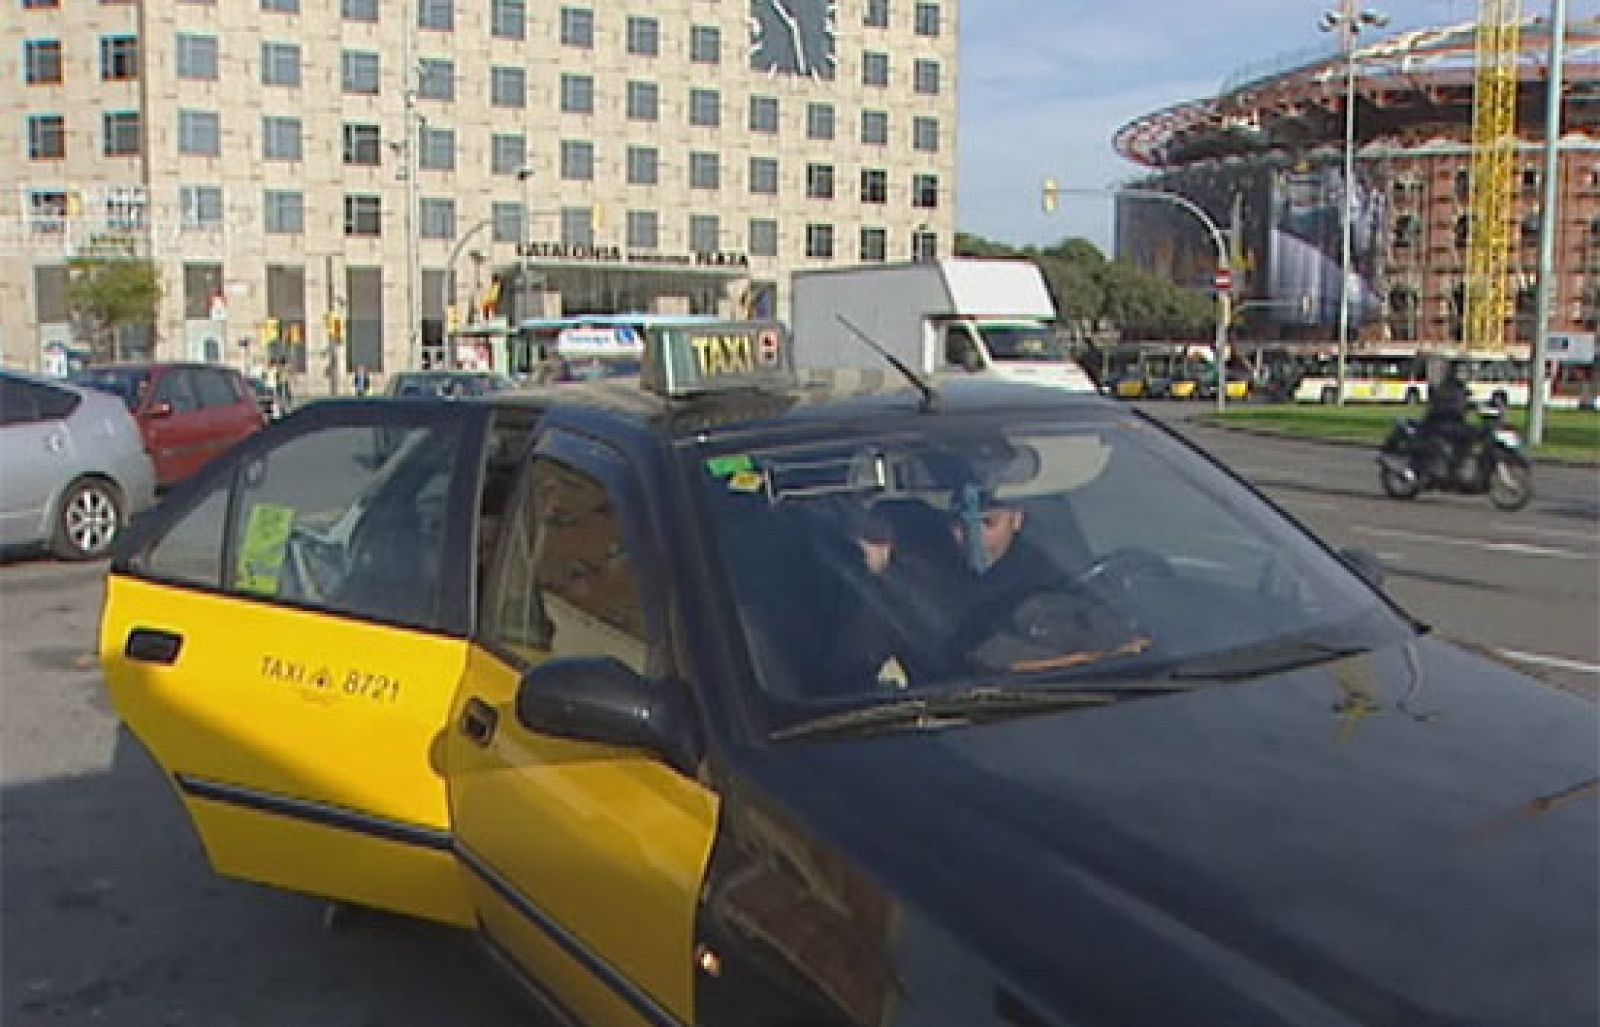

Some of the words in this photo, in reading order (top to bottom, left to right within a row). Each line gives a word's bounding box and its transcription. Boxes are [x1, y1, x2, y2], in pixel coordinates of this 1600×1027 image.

[692, 335, 756, 377] TAXI
[262, 655, 306, 682] TAXI
[343, 670, 400, 704] 8721
